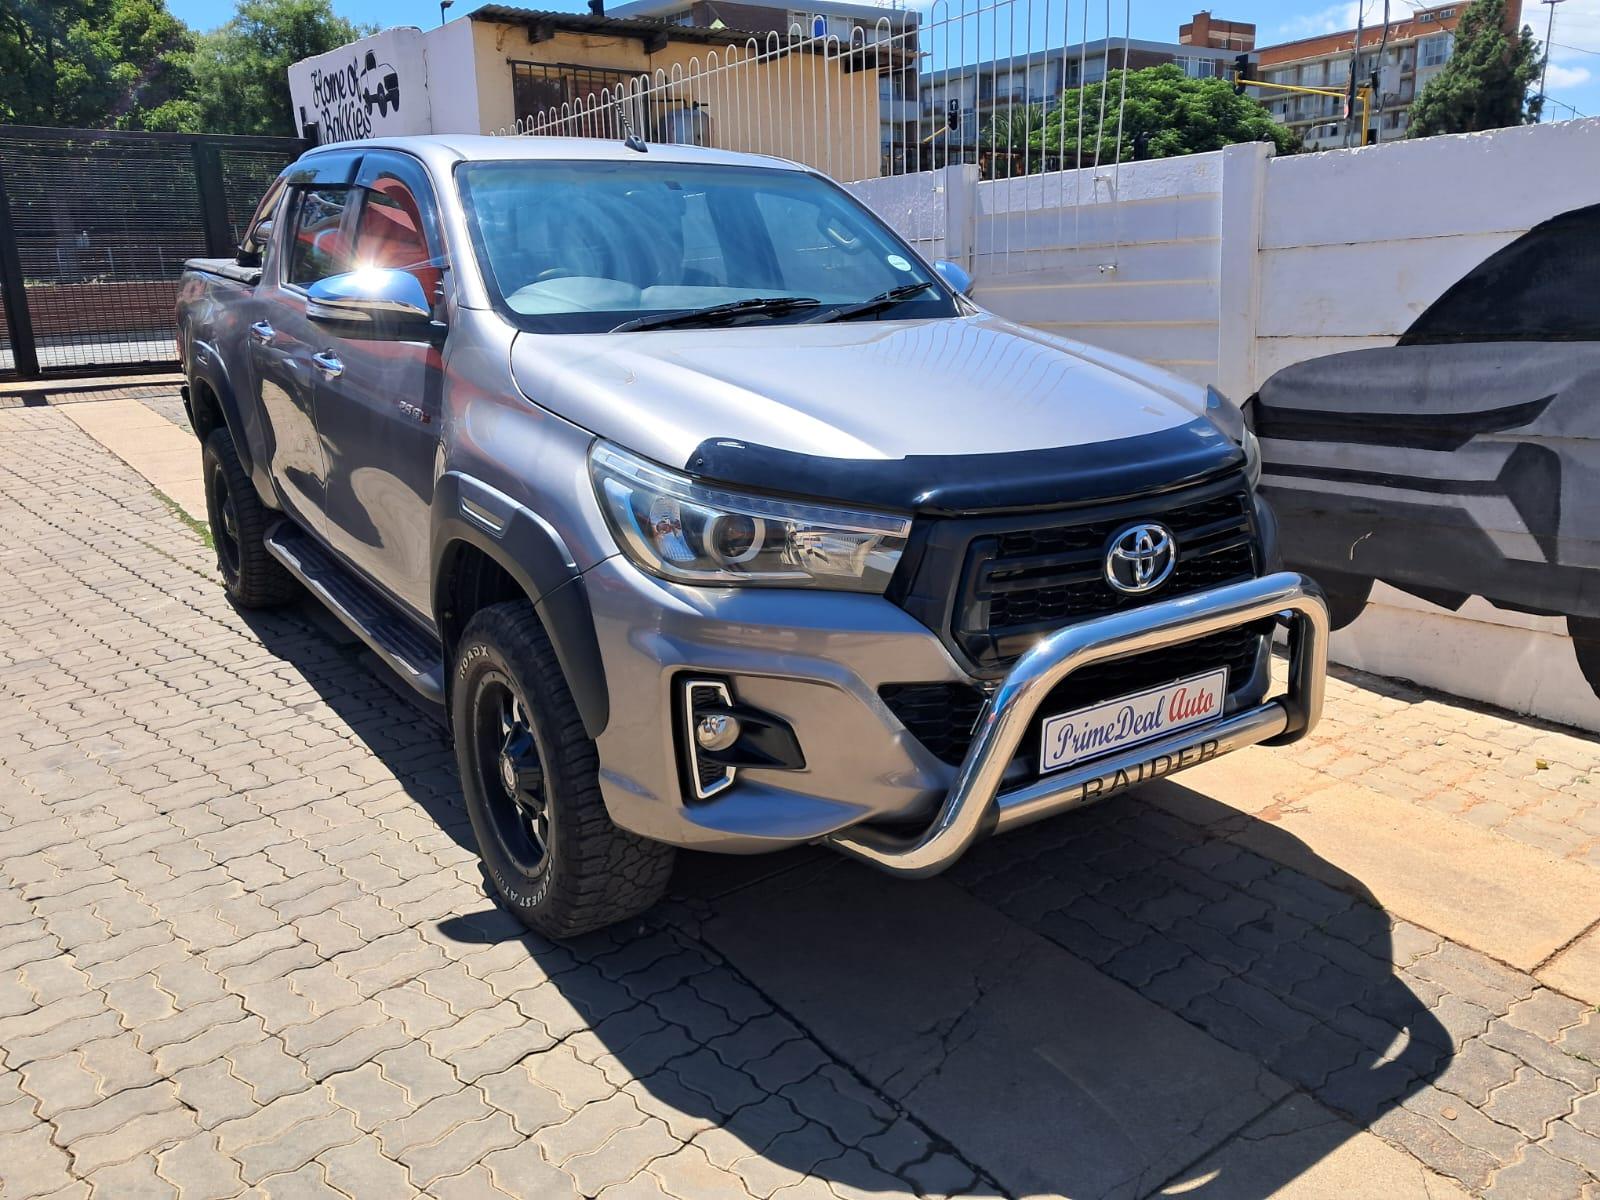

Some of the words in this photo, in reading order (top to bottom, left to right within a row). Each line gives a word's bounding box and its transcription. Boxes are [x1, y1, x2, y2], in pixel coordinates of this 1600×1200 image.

[311, 68, 347, 108] Home
[321, 101, 375, 144] Bakkies
[460, 645, 489, 680] ROADX
[1168, 687, 1215, 723] Auto
[1080, 738, 1219, 802] RAIDER
